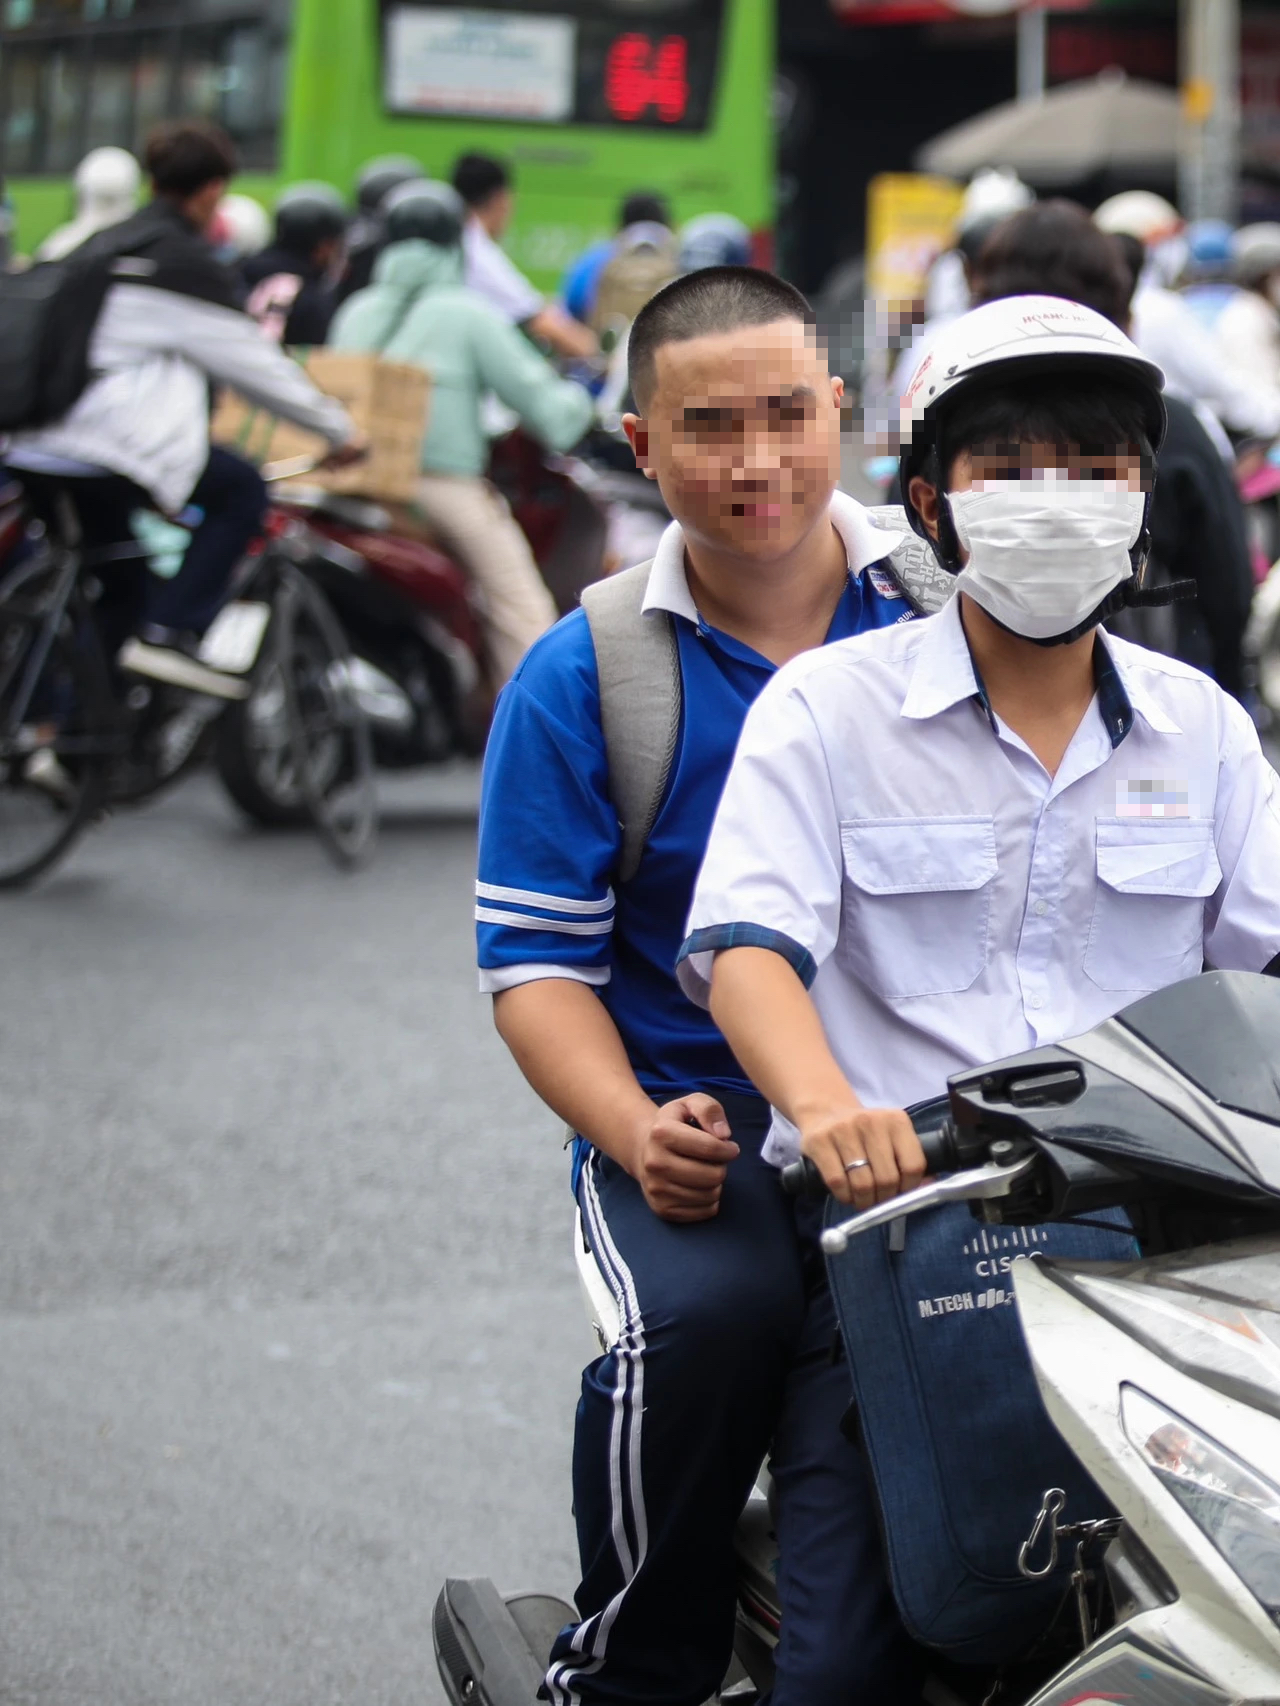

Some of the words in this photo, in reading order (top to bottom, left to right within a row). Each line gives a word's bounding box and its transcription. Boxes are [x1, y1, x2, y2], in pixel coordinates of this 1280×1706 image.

[605, 34, 689, 122] 64
[975, 1251, 1043, 1277] CIS
[918, 1291, 975, 1318] M.TECH
